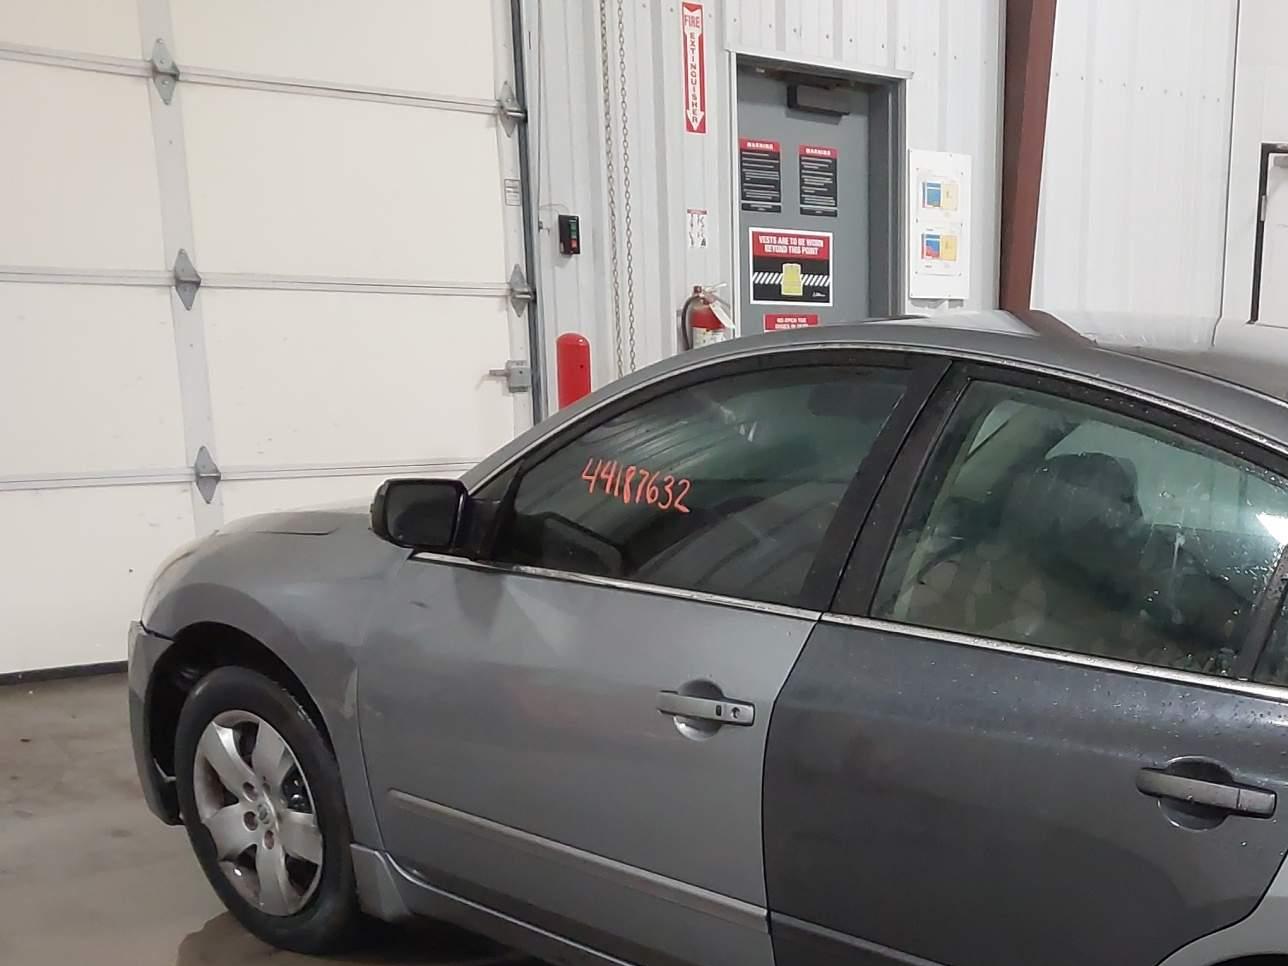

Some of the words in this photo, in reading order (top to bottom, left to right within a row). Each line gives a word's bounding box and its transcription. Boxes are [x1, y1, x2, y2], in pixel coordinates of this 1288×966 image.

[684, 14, 700, 28] FIRE
[690, 32, 698, 123] EXTINGUISHER
[582, 457, 692, 513] 44187632
